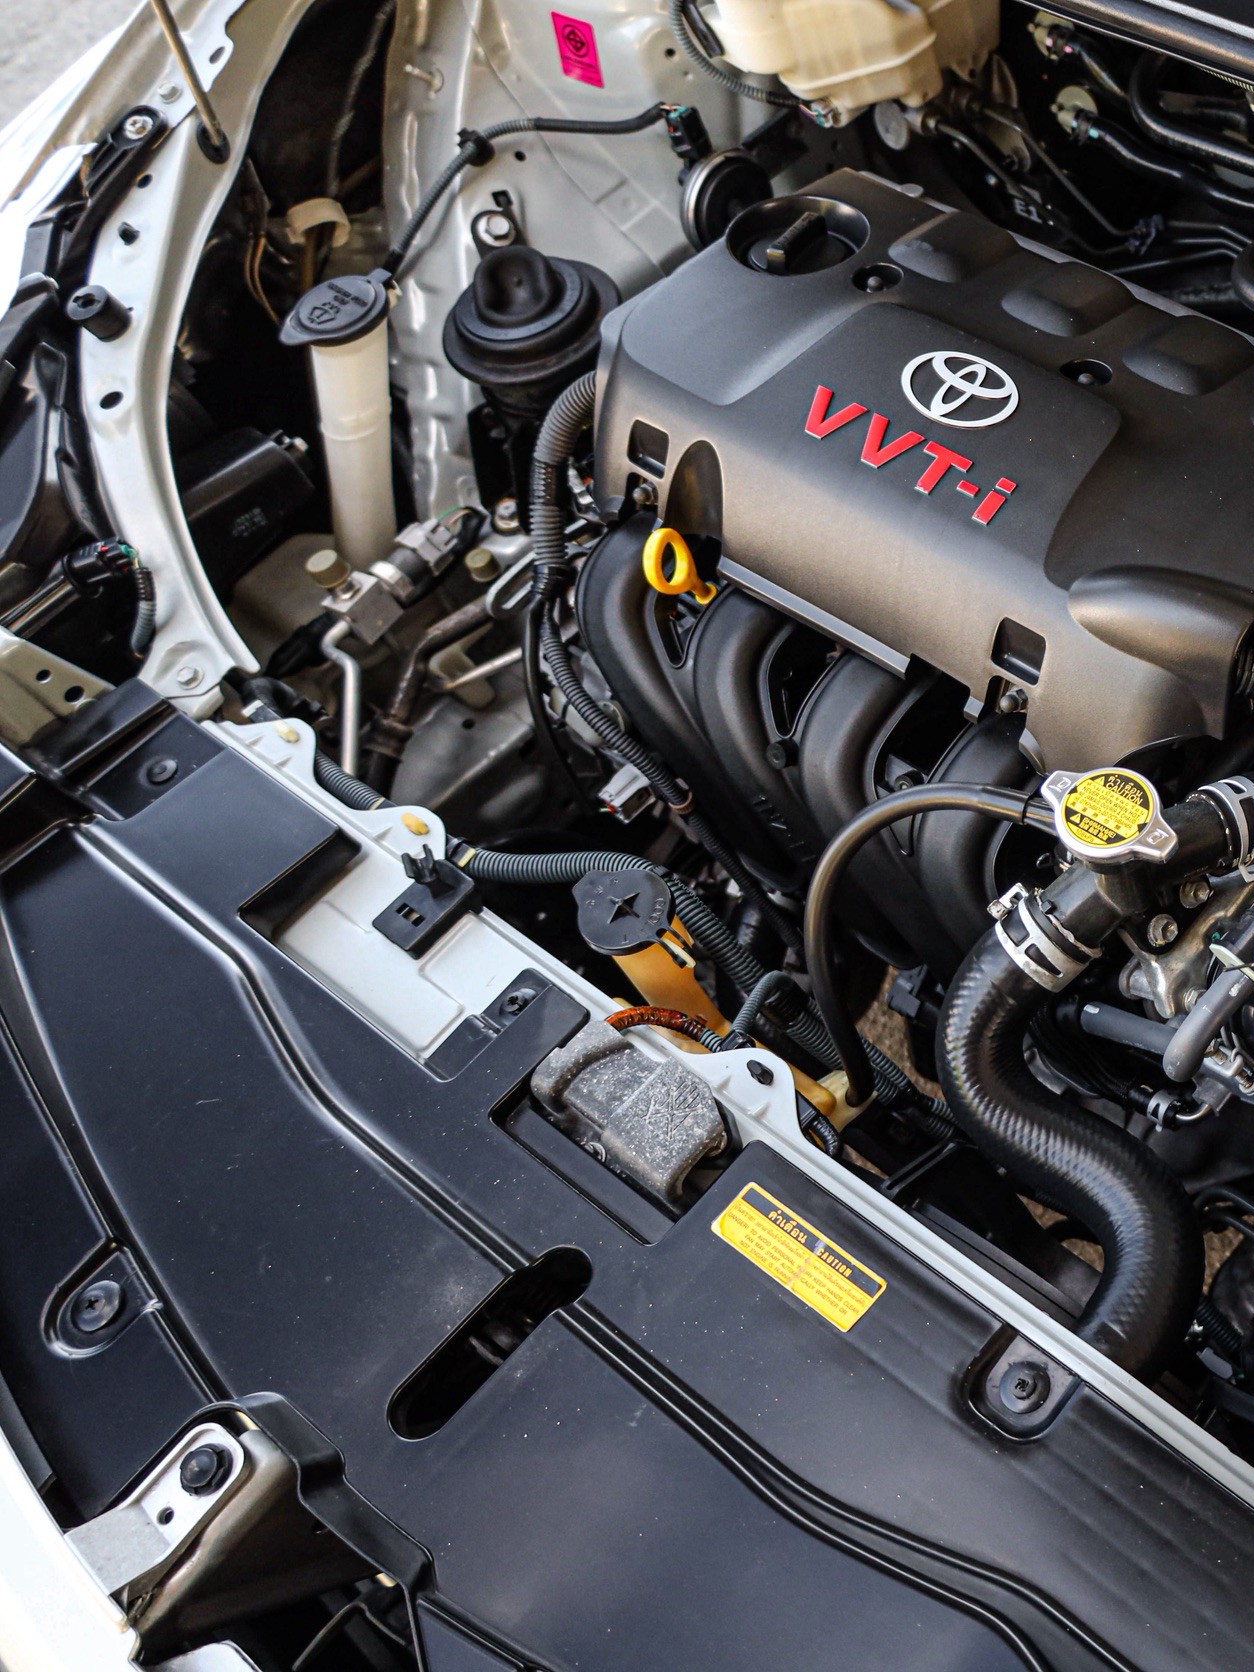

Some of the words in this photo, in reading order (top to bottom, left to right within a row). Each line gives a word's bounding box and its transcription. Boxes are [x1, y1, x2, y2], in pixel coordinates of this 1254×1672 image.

[805, 385, 1017, 525] VVT-i
[1106, 783, 1143, 805] CAUTION
[770, 1245, 795, 1266] PERSONAL
[825, 1287, 843, 1302] HANDS
[816, 1247, 852, 1277] CAUTION
